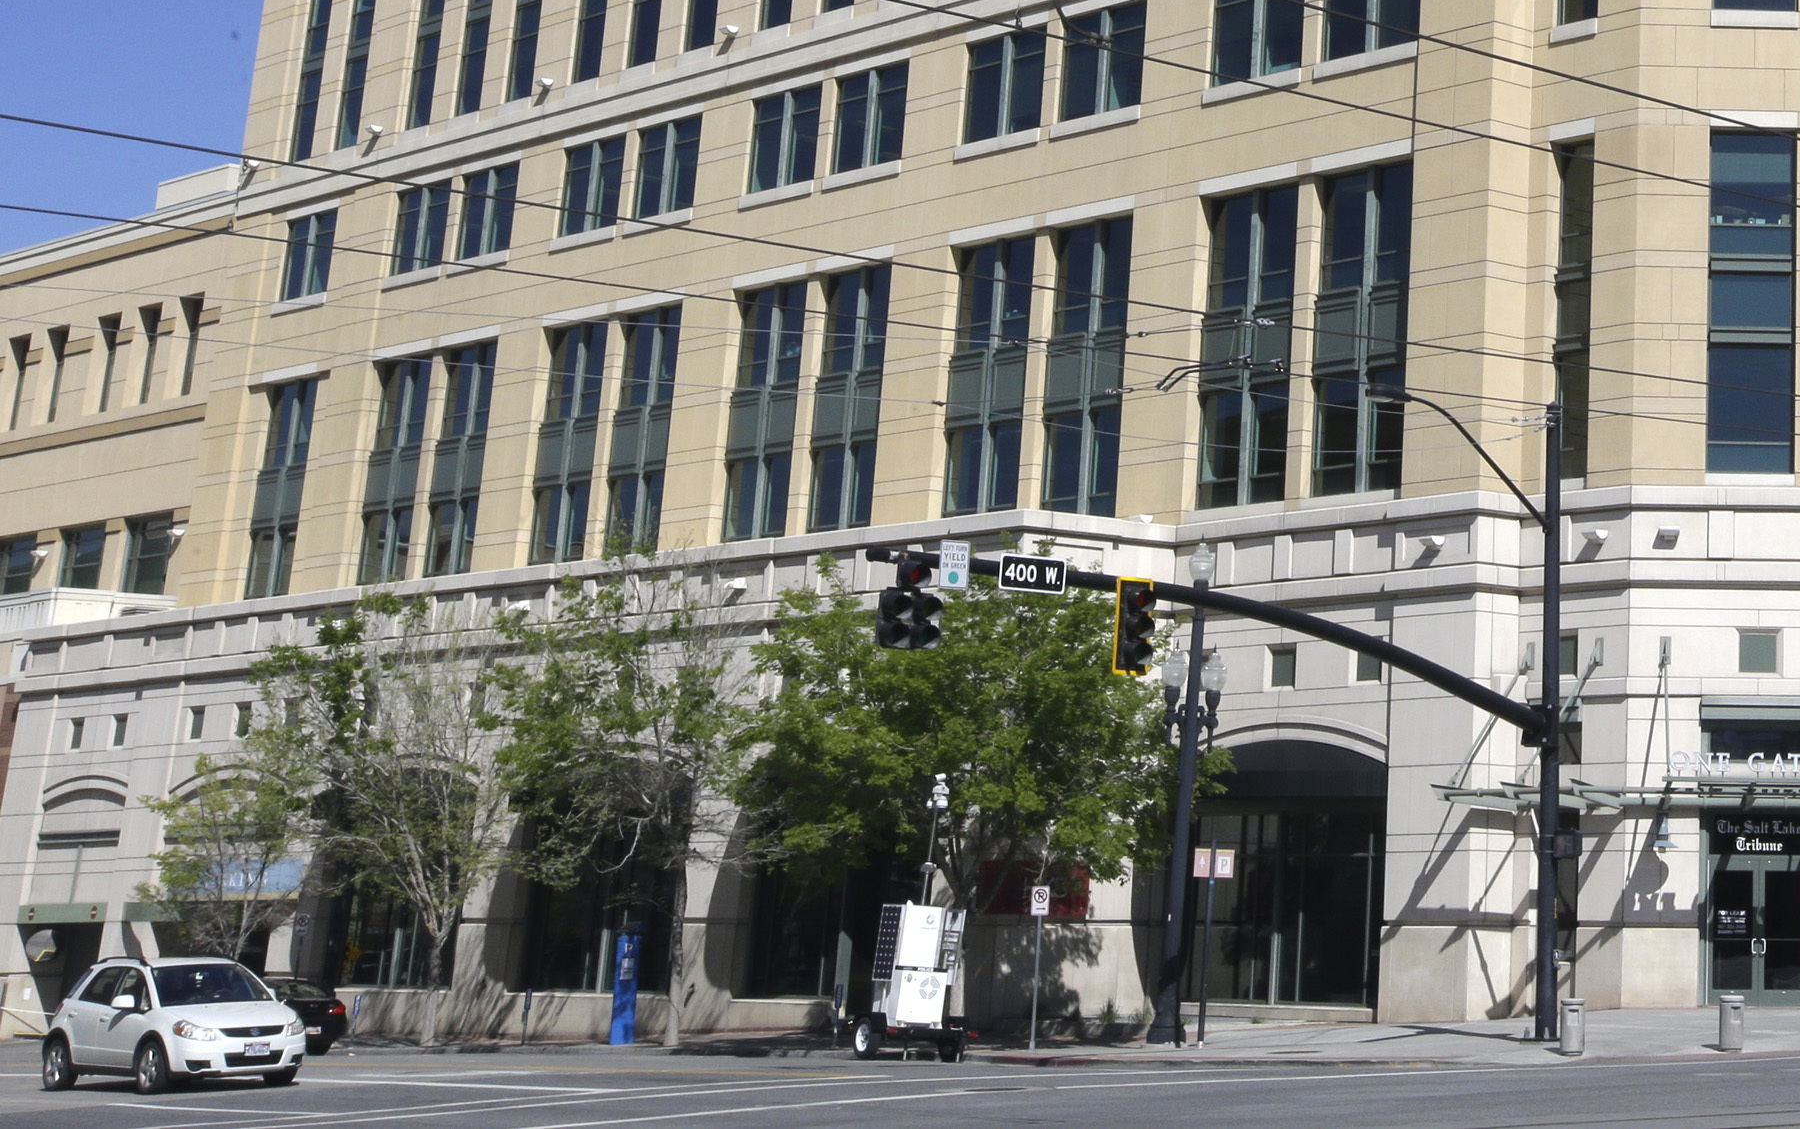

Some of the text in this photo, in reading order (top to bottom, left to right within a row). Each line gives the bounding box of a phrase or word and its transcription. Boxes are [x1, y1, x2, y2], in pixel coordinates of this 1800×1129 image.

[944, 553, 966, 561] YIELD
[1005, 563, 1060, 584] 400 W.
[1669, 751, 1730, 771] ONE
[1717, 819, 1740, 834] The
[1742, 820, 1768, 836] Salt
[1736, 836, 1783, 851] Tribune
